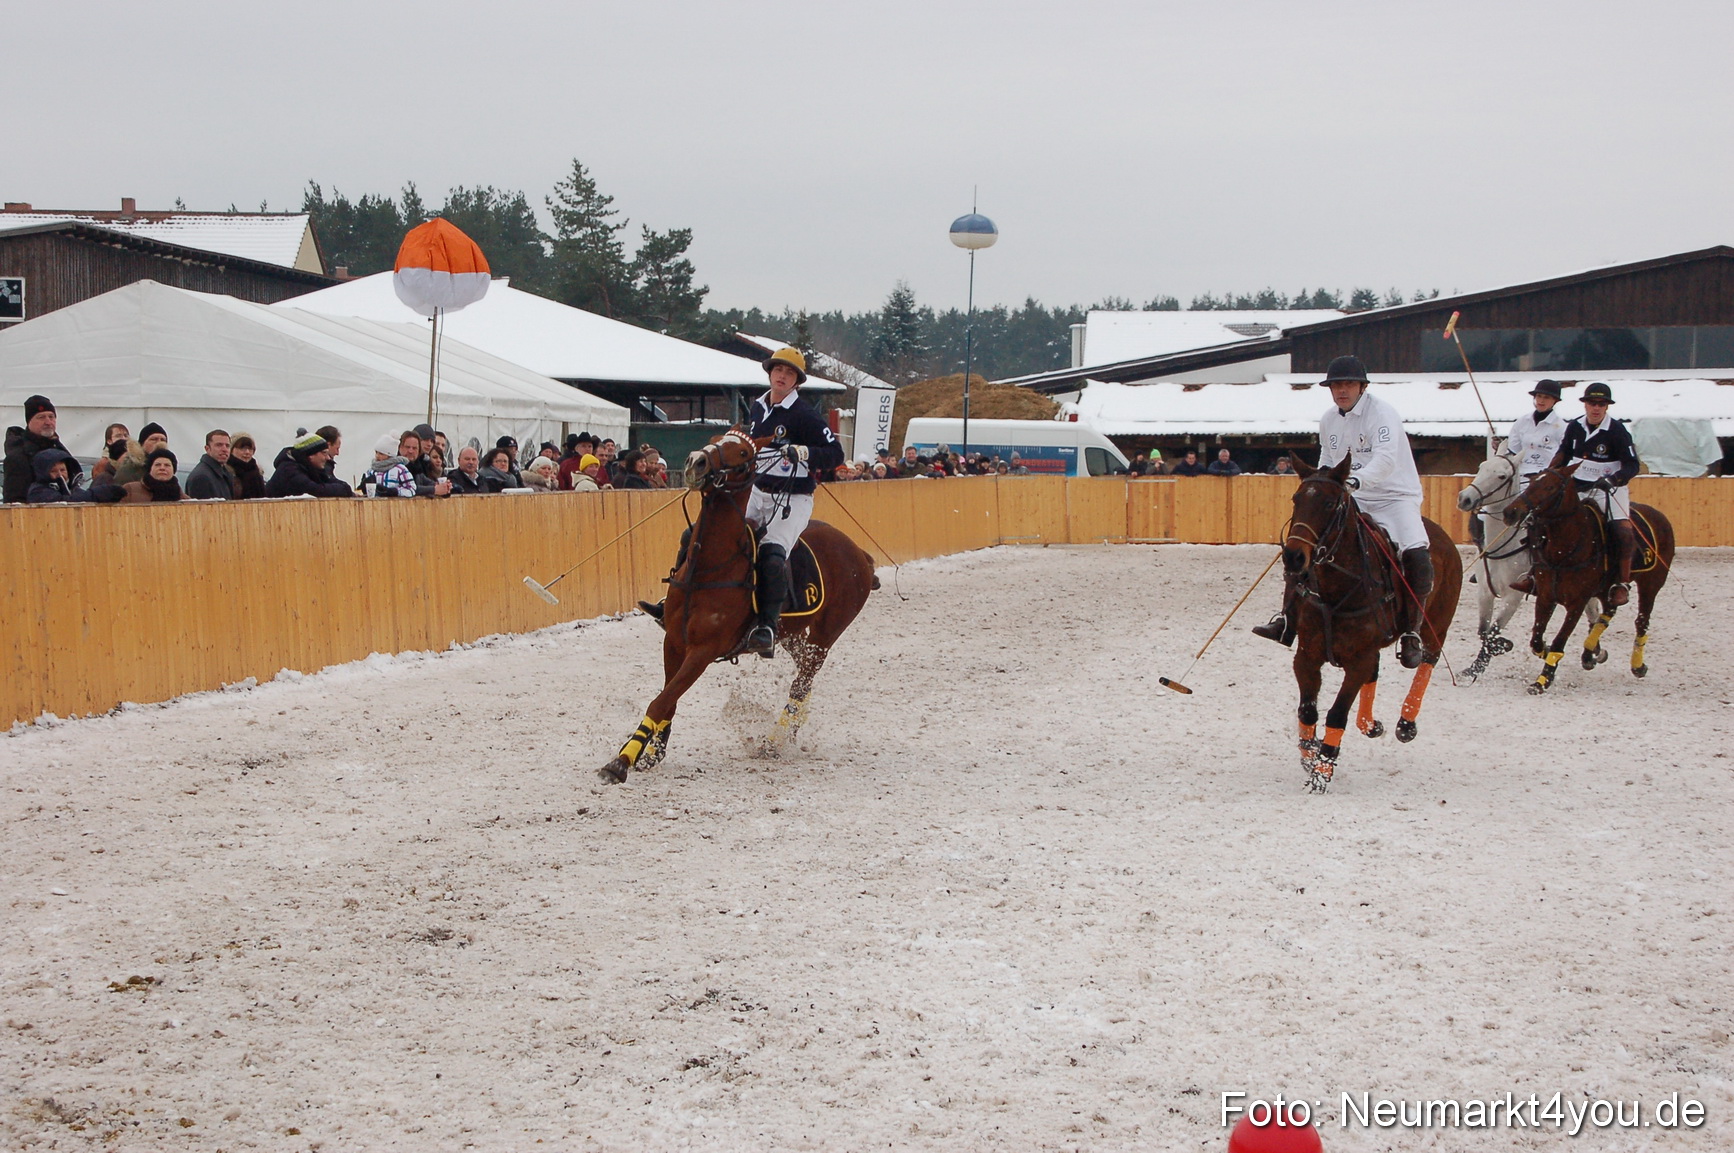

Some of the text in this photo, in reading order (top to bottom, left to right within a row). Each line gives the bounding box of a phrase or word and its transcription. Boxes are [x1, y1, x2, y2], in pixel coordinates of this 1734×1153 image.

[822, 427, 835, 443] 2
[873, 395, 891, 460] ÖLKERS
[1378, 426, 1390, 443] 2
[1329, 434, 1338, 450] 2
[805, 586, 817, 606] R
